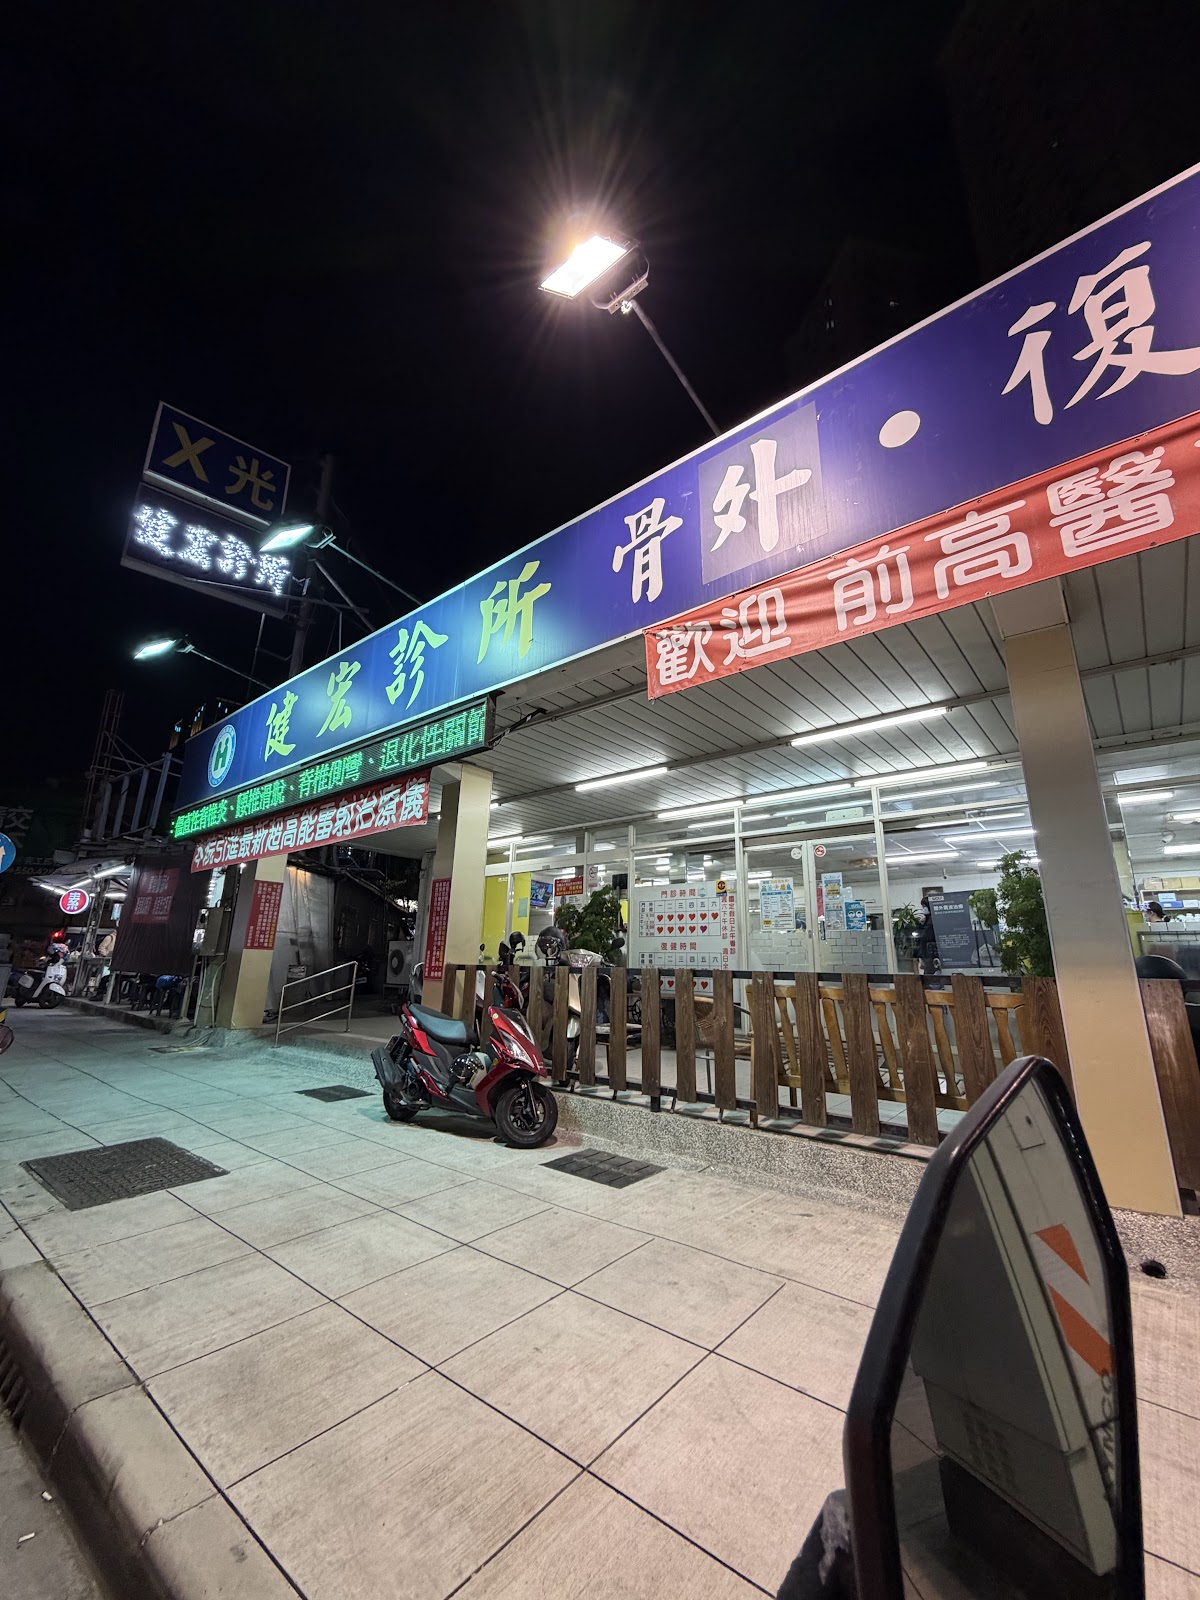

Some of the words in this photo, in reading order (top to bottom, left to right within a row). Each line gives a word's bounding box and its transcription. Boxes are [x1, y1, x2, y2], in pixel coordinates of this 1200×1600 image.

[162, 421, 277, 511] X光
[655, 594, 792, 687] 歡迎
[826, 440, 1200, 632] 前高醫
[263, 560, 551, 763] 健宏診所
[660, 888, 696, 898] 門診時間
